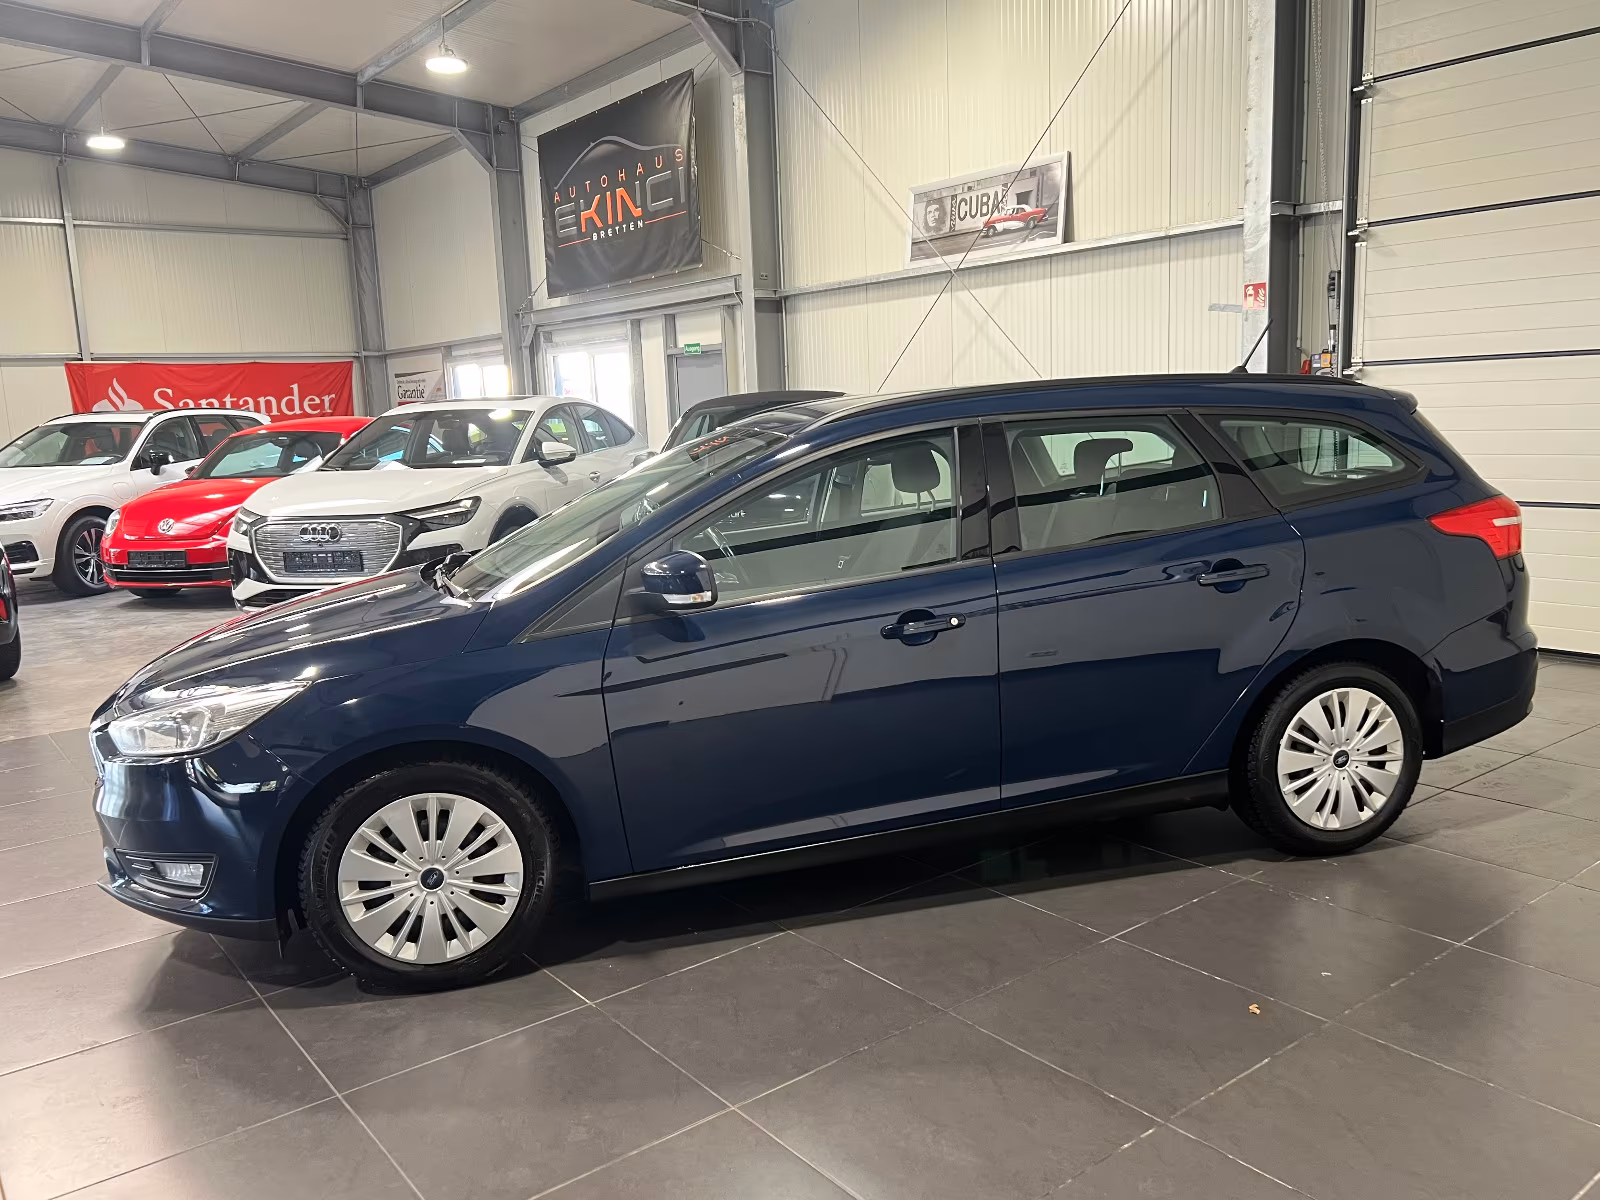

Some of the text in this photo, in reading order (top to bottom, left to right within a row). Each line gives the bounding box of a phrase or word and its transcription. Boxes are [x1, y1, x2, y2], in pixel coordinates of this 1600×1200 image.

[554, 148, 684, 203] AUTOHAUS
[554, 166, 687, 238] EKINCI
[957, 190, 1001, 222] CUBA
[592, 219, 643, 241] BRETTEN
[153, 383, 336, 416] Santander
